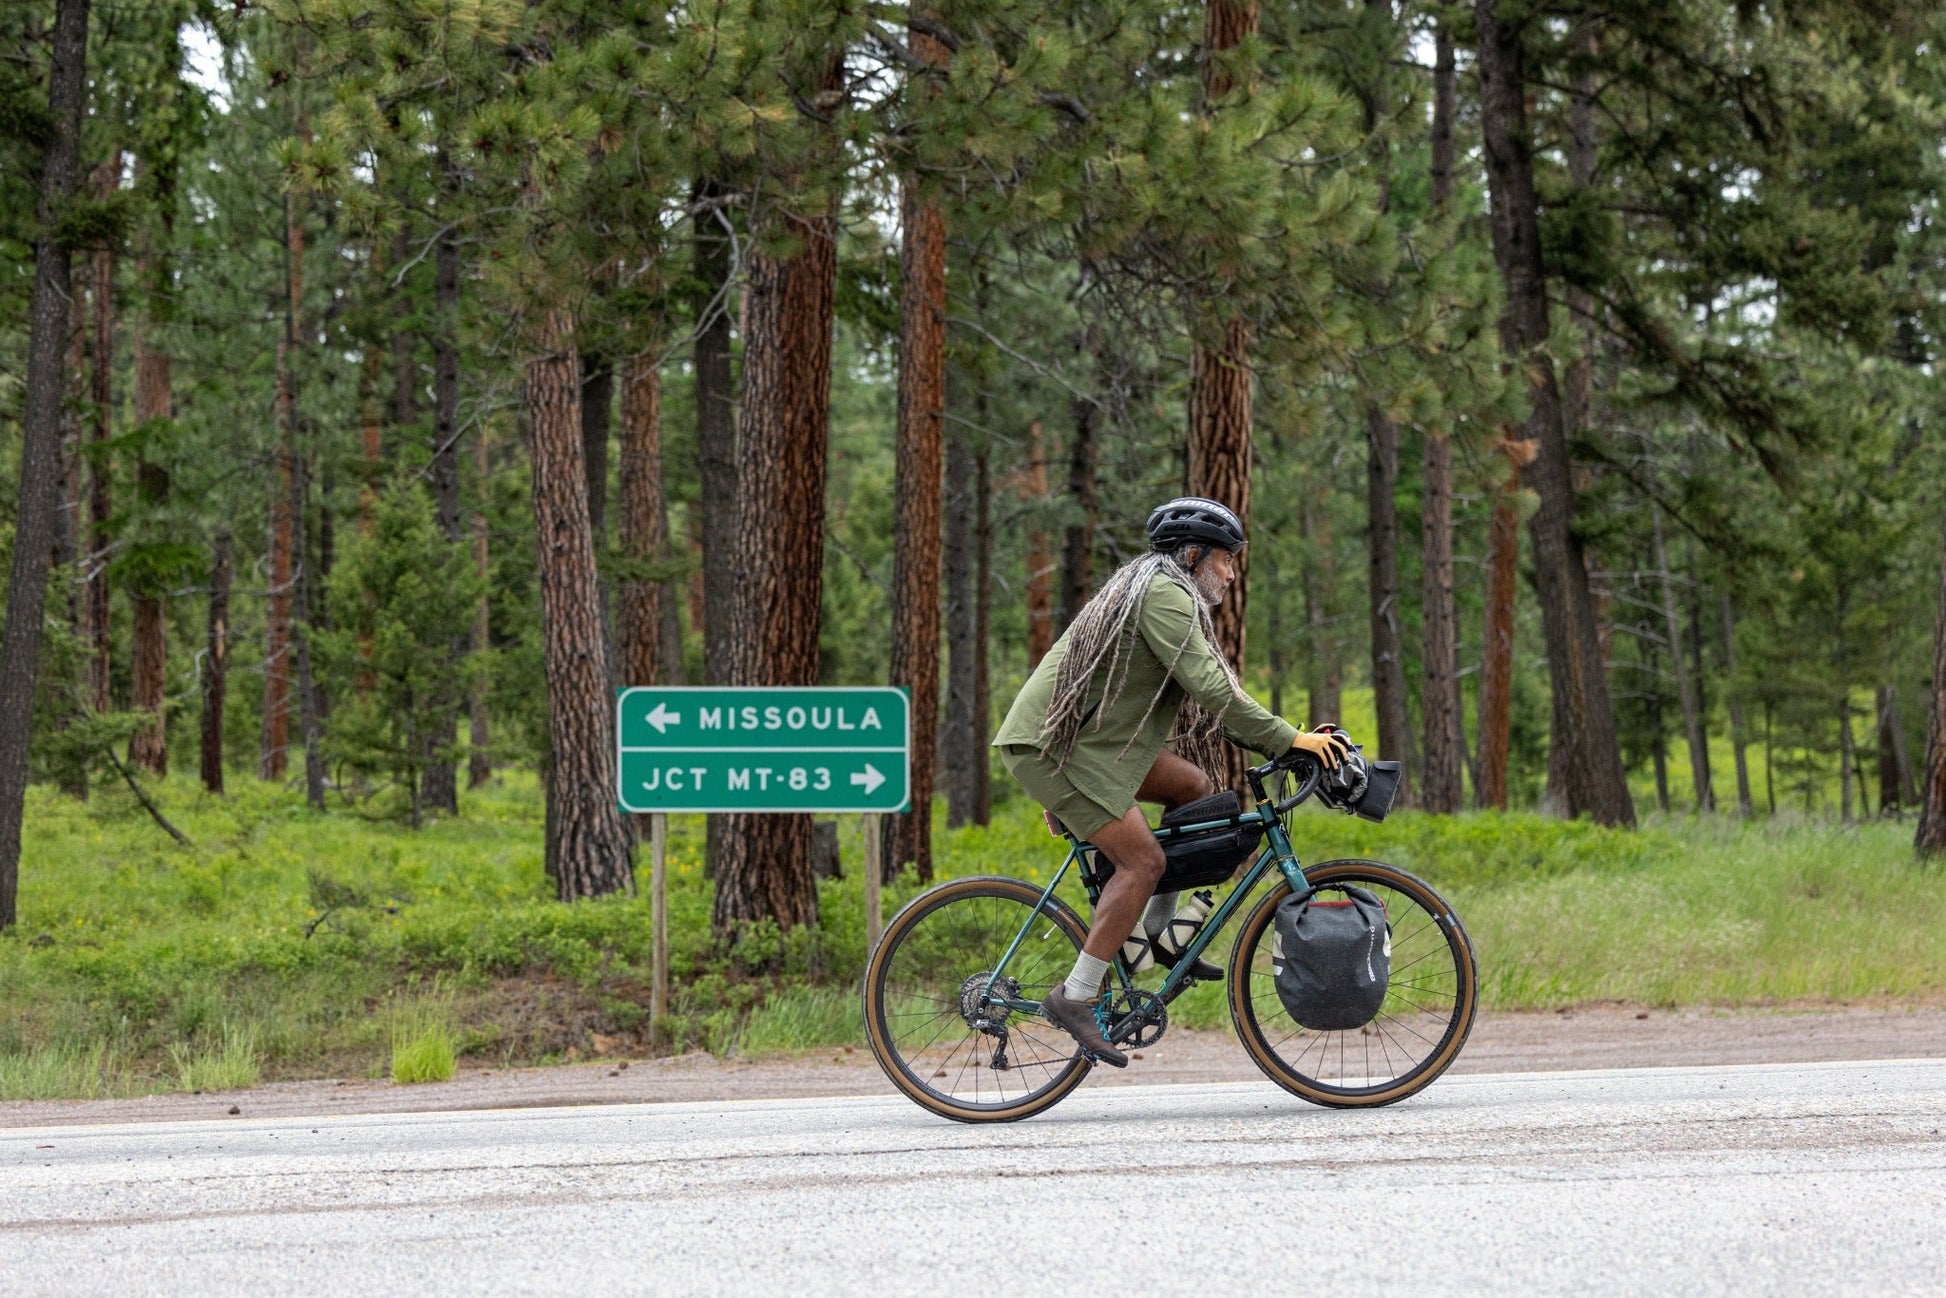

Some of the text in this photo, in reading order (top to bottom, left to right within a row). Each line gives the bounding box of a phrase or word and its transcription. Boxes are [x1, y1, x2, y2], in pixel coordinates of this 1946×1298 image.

[699, 706, 882, 730] MISSOULA
[642, 767, 831, 791] JCT MT-83
